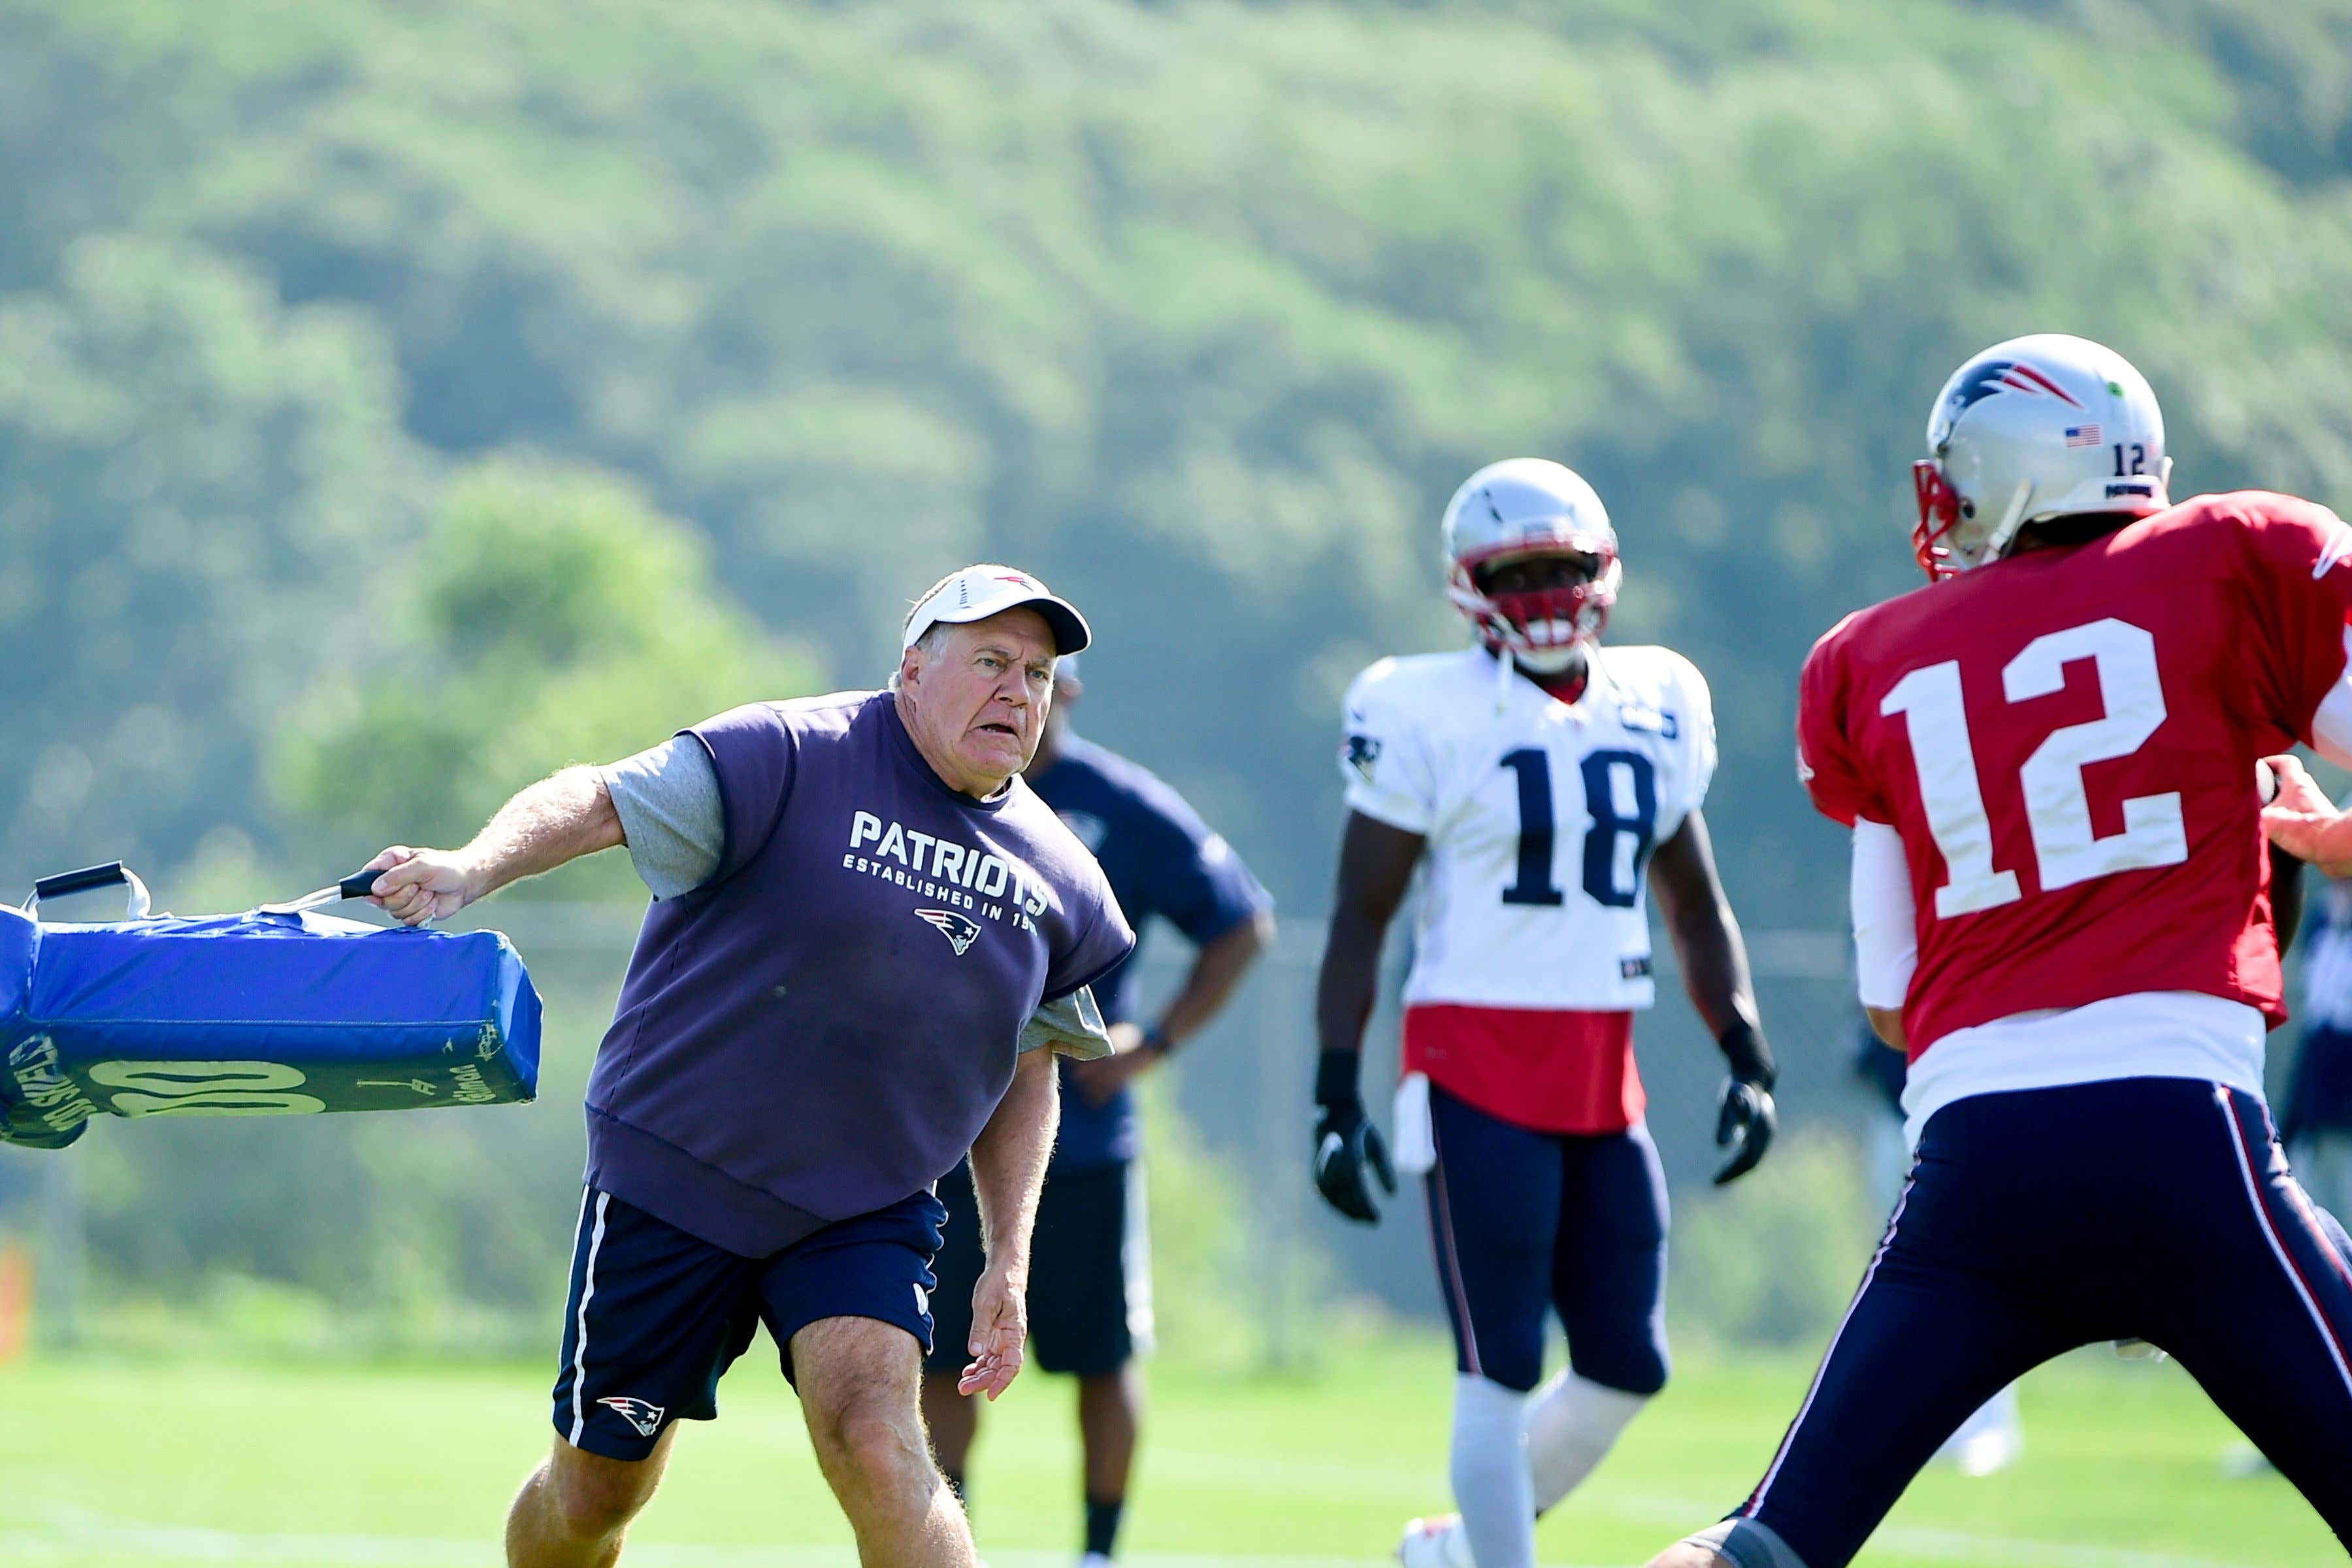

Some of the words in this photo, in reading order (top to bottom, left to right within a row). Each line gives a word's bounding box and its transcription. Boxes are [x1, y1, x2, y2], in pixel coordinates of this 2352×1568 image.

[2114, 442, 2145, 477] 12
[1880, 617, 2189, 921] 12
[849, 810, 1048, 917] PATRIOTS
[1499, 748, 1657, 907] 18
[843, 853, 973, 910] ESTABLISHED
[981, 903, 1004, 921] IN
